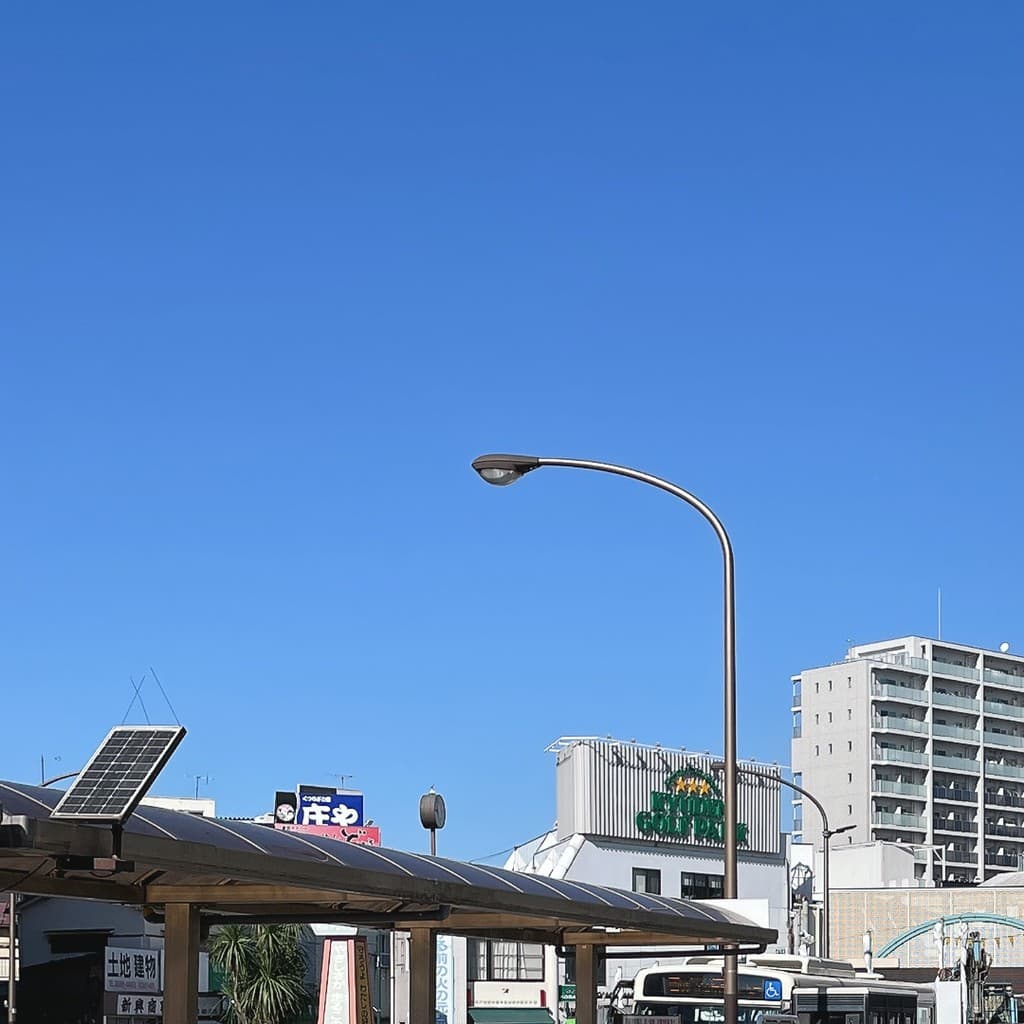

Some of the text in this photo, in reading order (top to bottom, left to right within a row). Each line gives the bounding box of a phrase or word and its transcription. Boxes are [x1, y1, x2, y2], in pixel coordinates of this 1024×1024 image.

[302, 803, 358, 826] 庄や
[121, 997, 163, 1013] 新興商
